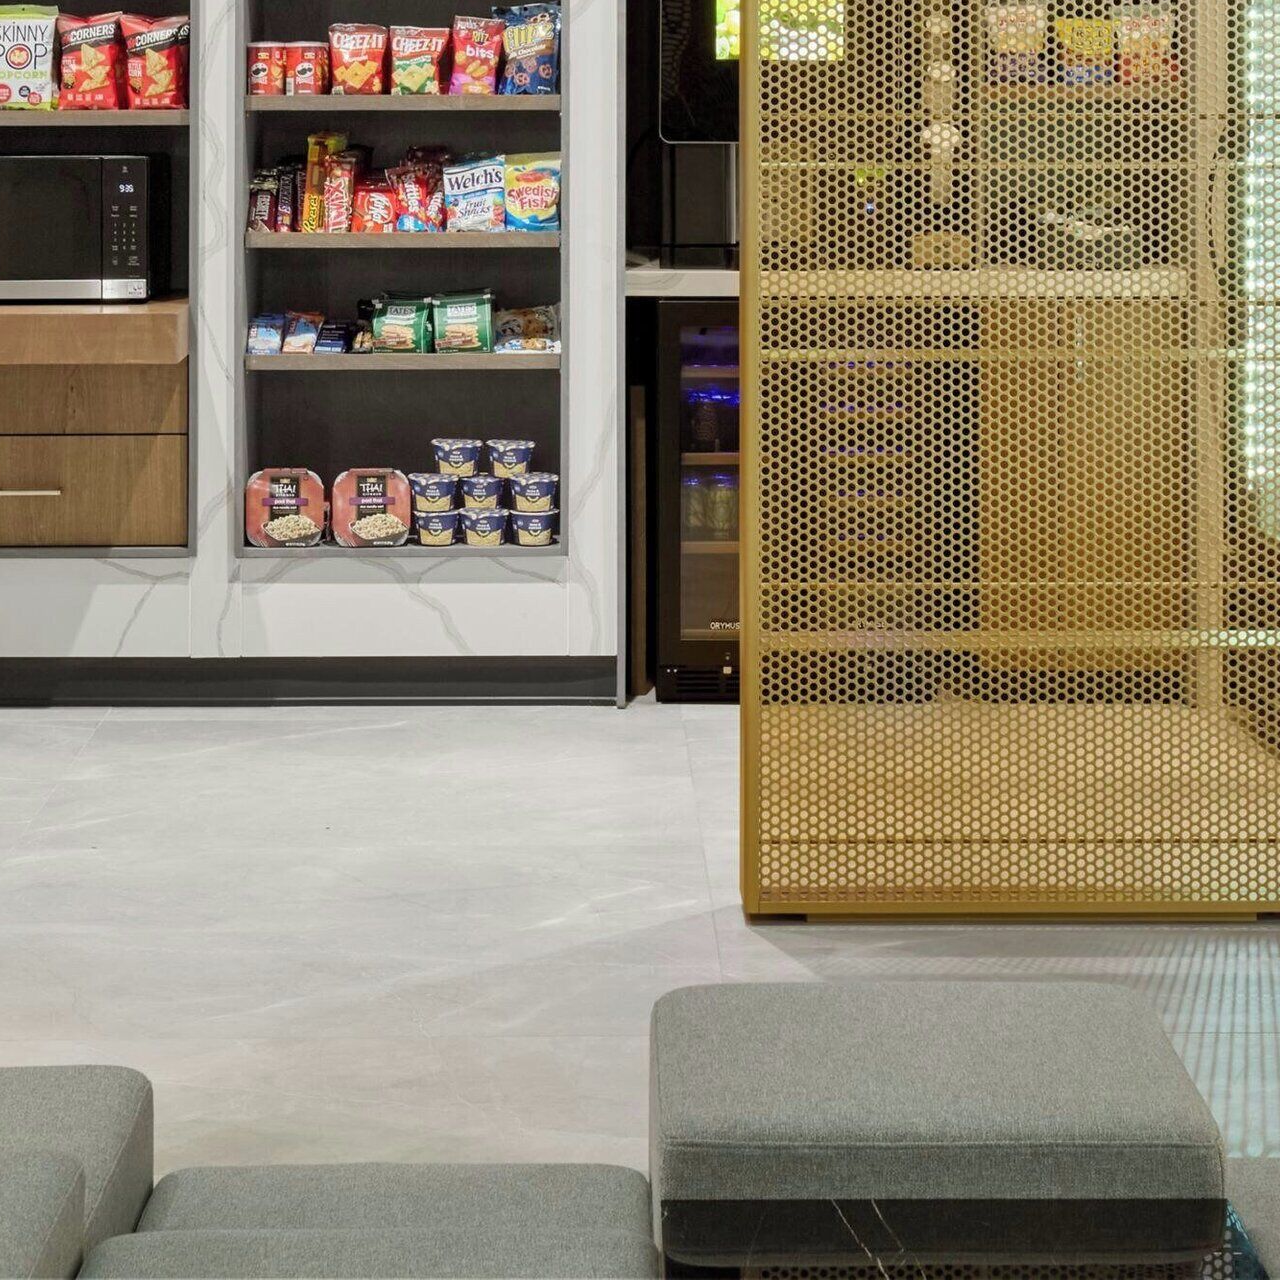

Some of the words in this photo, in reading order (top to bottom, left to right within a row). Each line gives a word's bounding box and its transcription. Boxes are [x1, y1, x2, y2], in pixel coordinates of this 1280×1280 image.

[332, 33, 385, 50] CHEEZ-IT
[392, 36, 445, 54] CHEEZ-IT
[465, 45, 494, 58] bits
[448, 168, 503, 191] Welch's
[507, 186, 559, 203] Swedish
[520, 197, 548, 210] Fish
[271, 484, 296, 494] THAI
[359, 483, 383, 493] THAI
